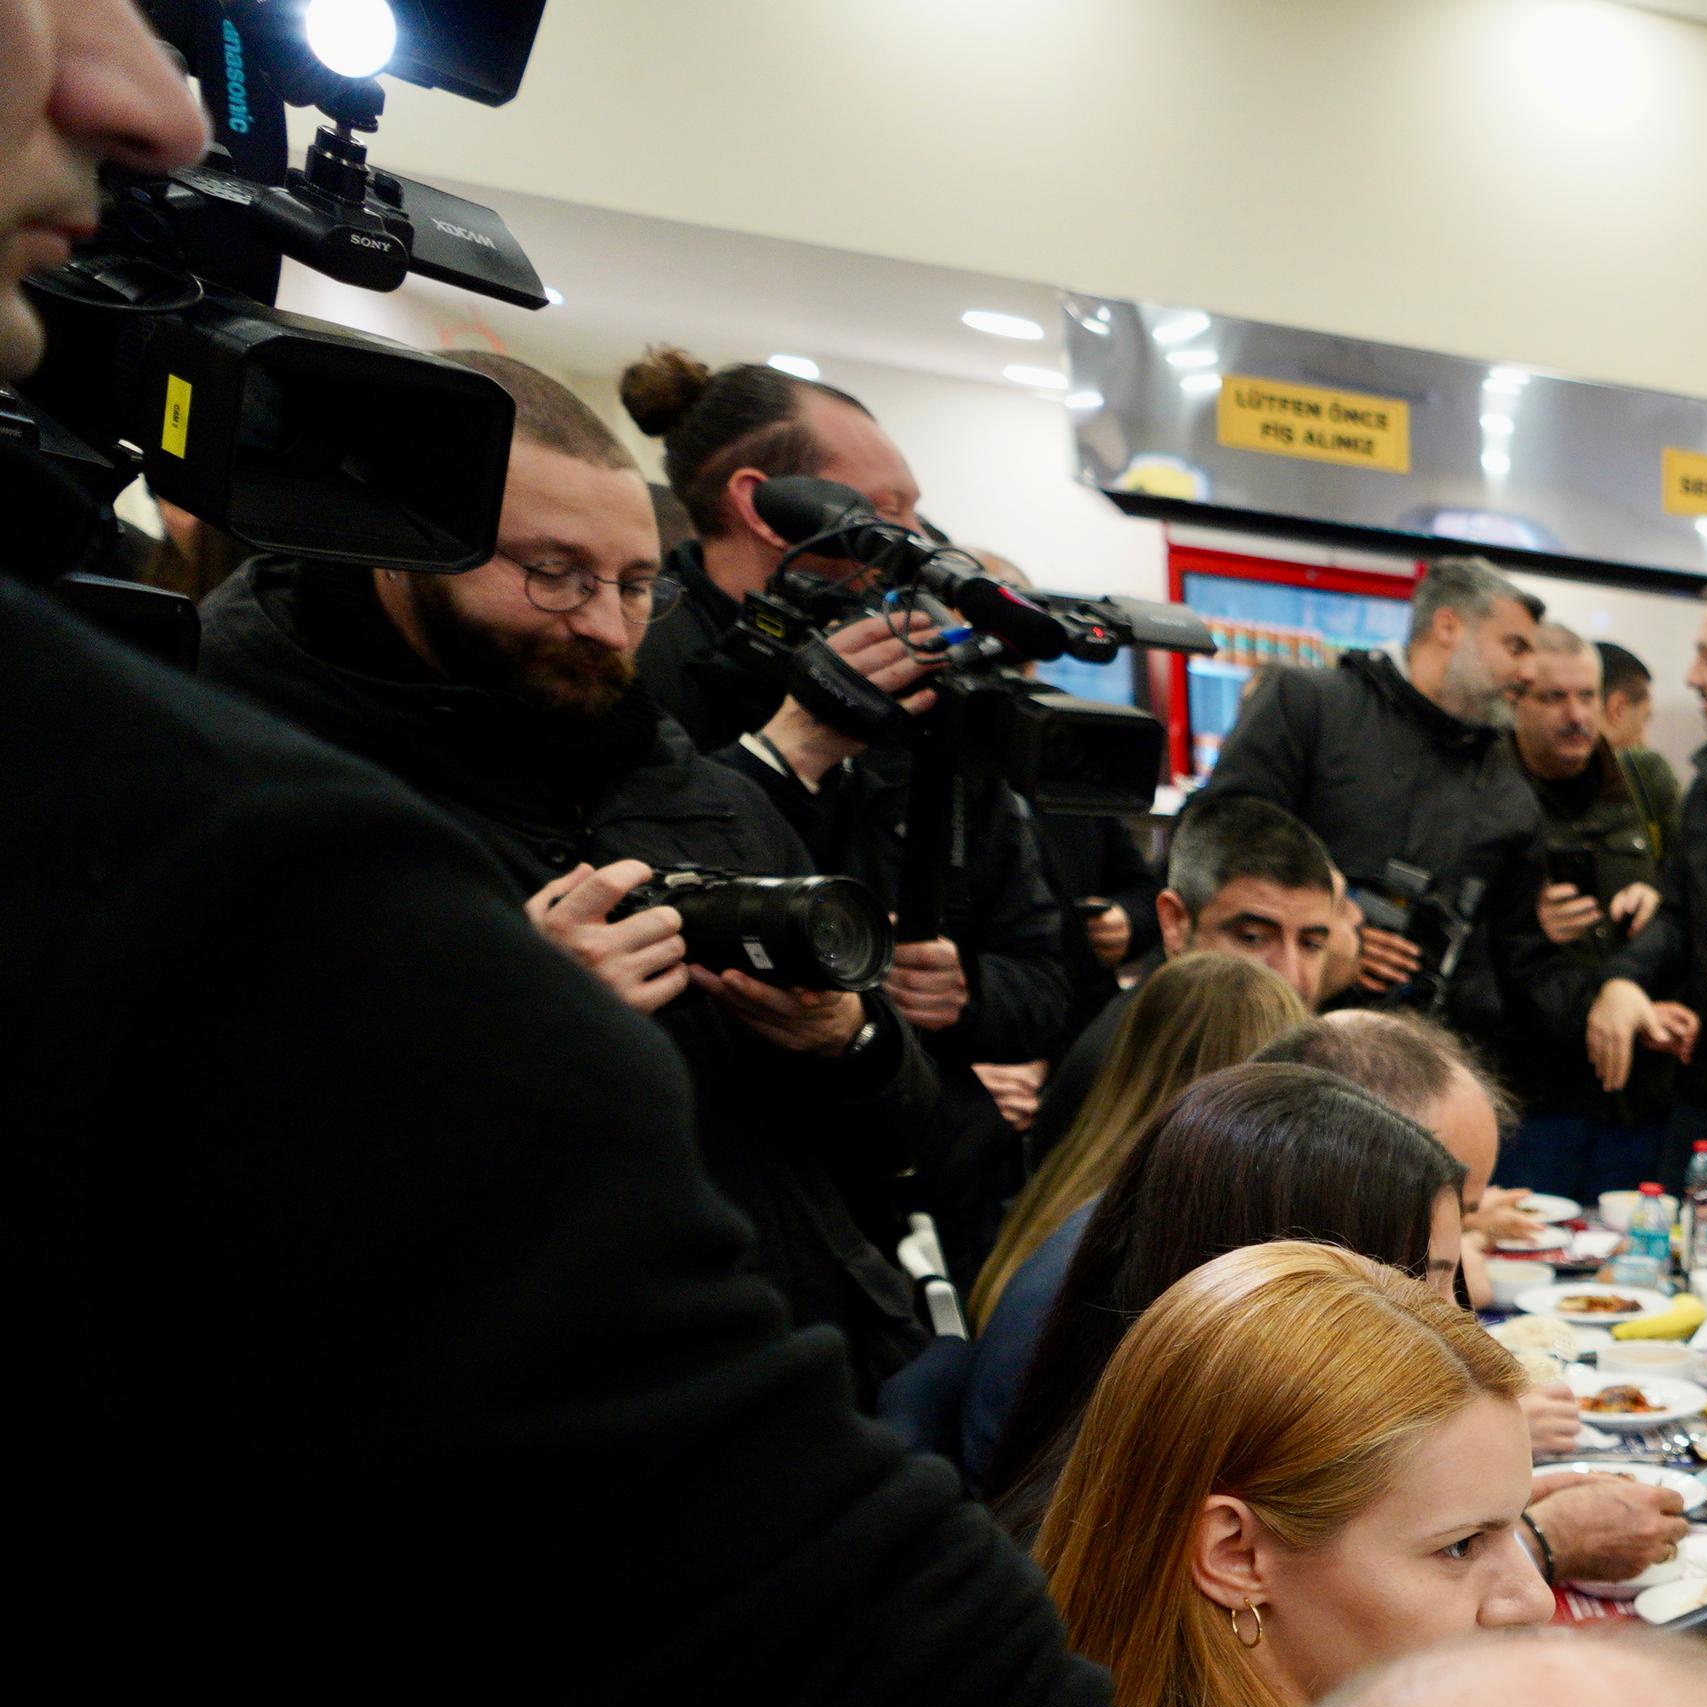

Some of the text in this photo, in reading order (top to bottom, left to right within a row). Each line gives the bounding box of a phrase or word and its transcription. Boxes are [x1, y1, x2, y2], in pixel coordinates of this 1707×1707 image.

[350, 233, 392, 253] SONY
[1234, 387, 1389, 431] LÜTFEN ÖNCE
[1303, 428, 1376, 457] ALINIZ
